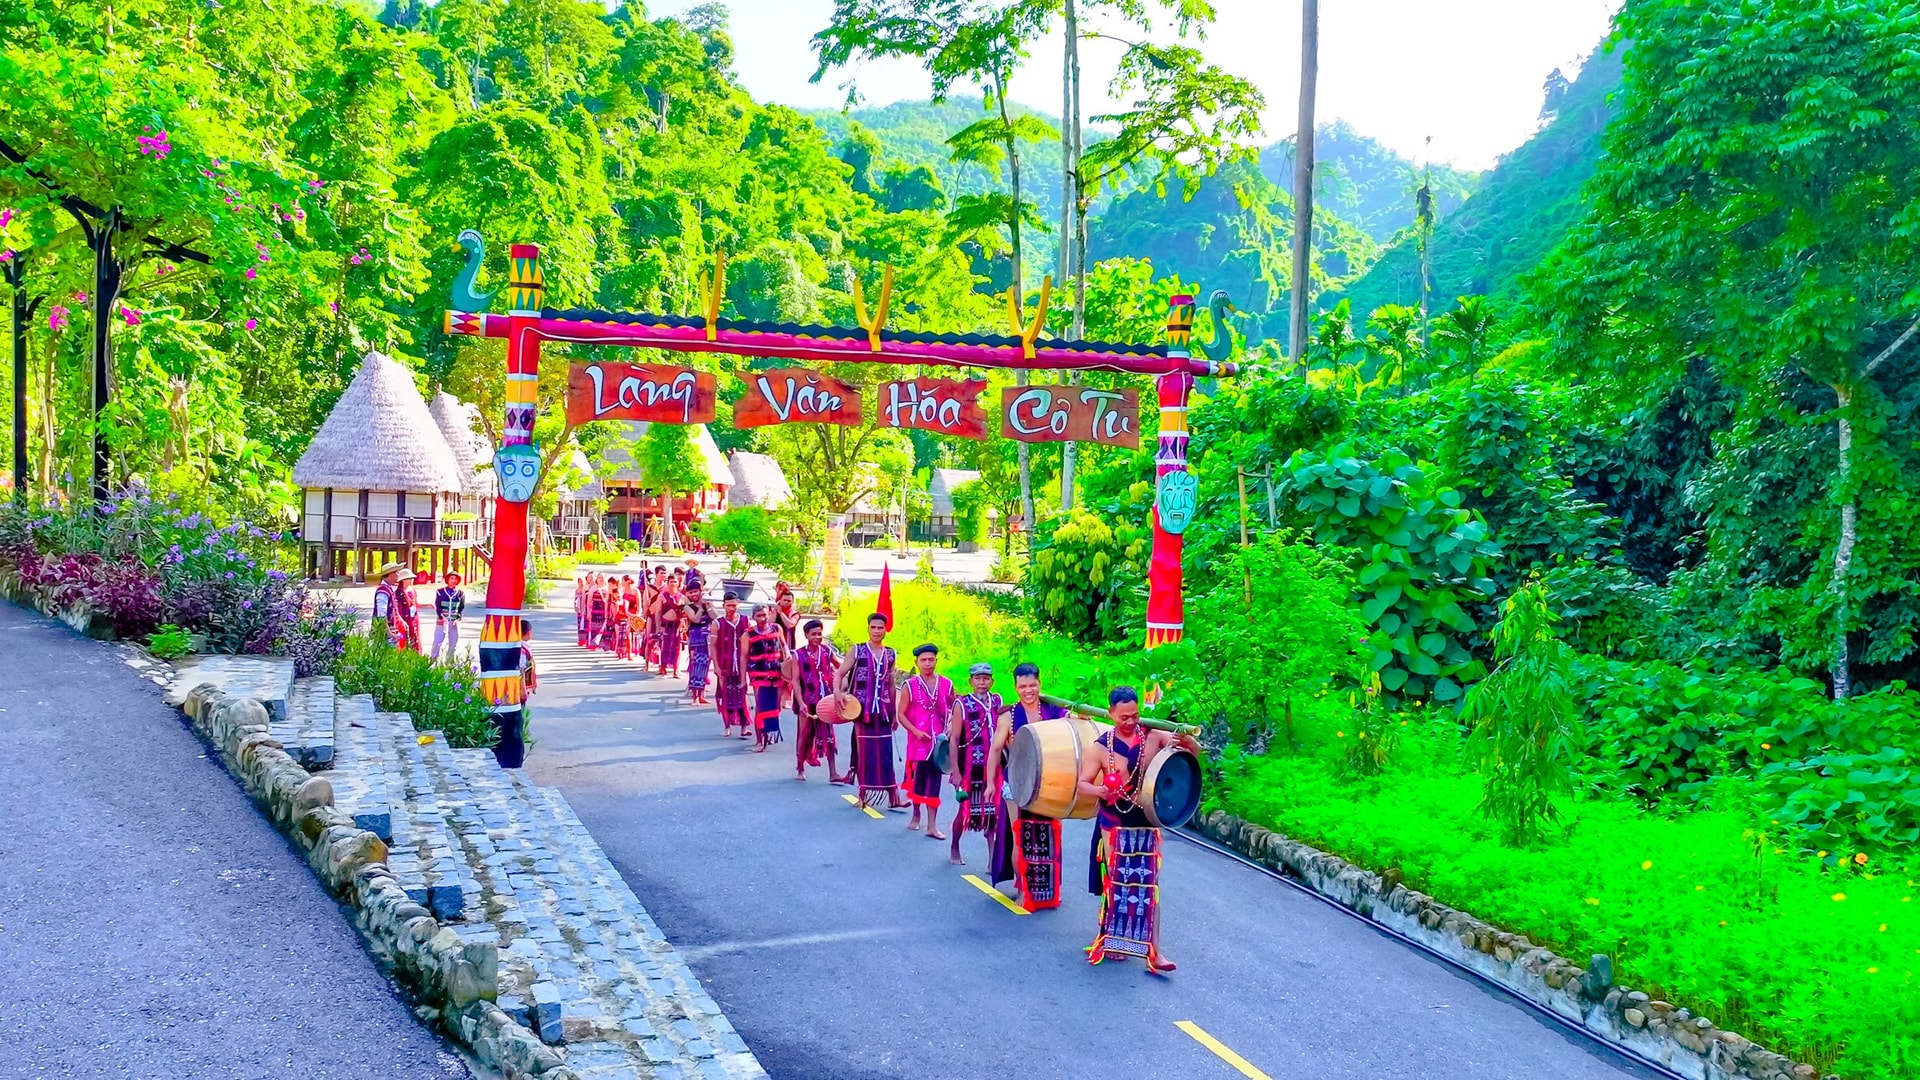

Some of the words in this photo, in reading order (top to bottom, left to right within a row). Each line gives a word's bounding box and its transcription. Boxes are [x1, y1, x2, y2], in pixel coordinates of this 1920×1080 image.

[584, 364, 696, 423] Làng
[757, 374, 843, 420] Văn
[885, 382, 962, 428] Hóa
[1080, 389, 1132, 440] Tu
